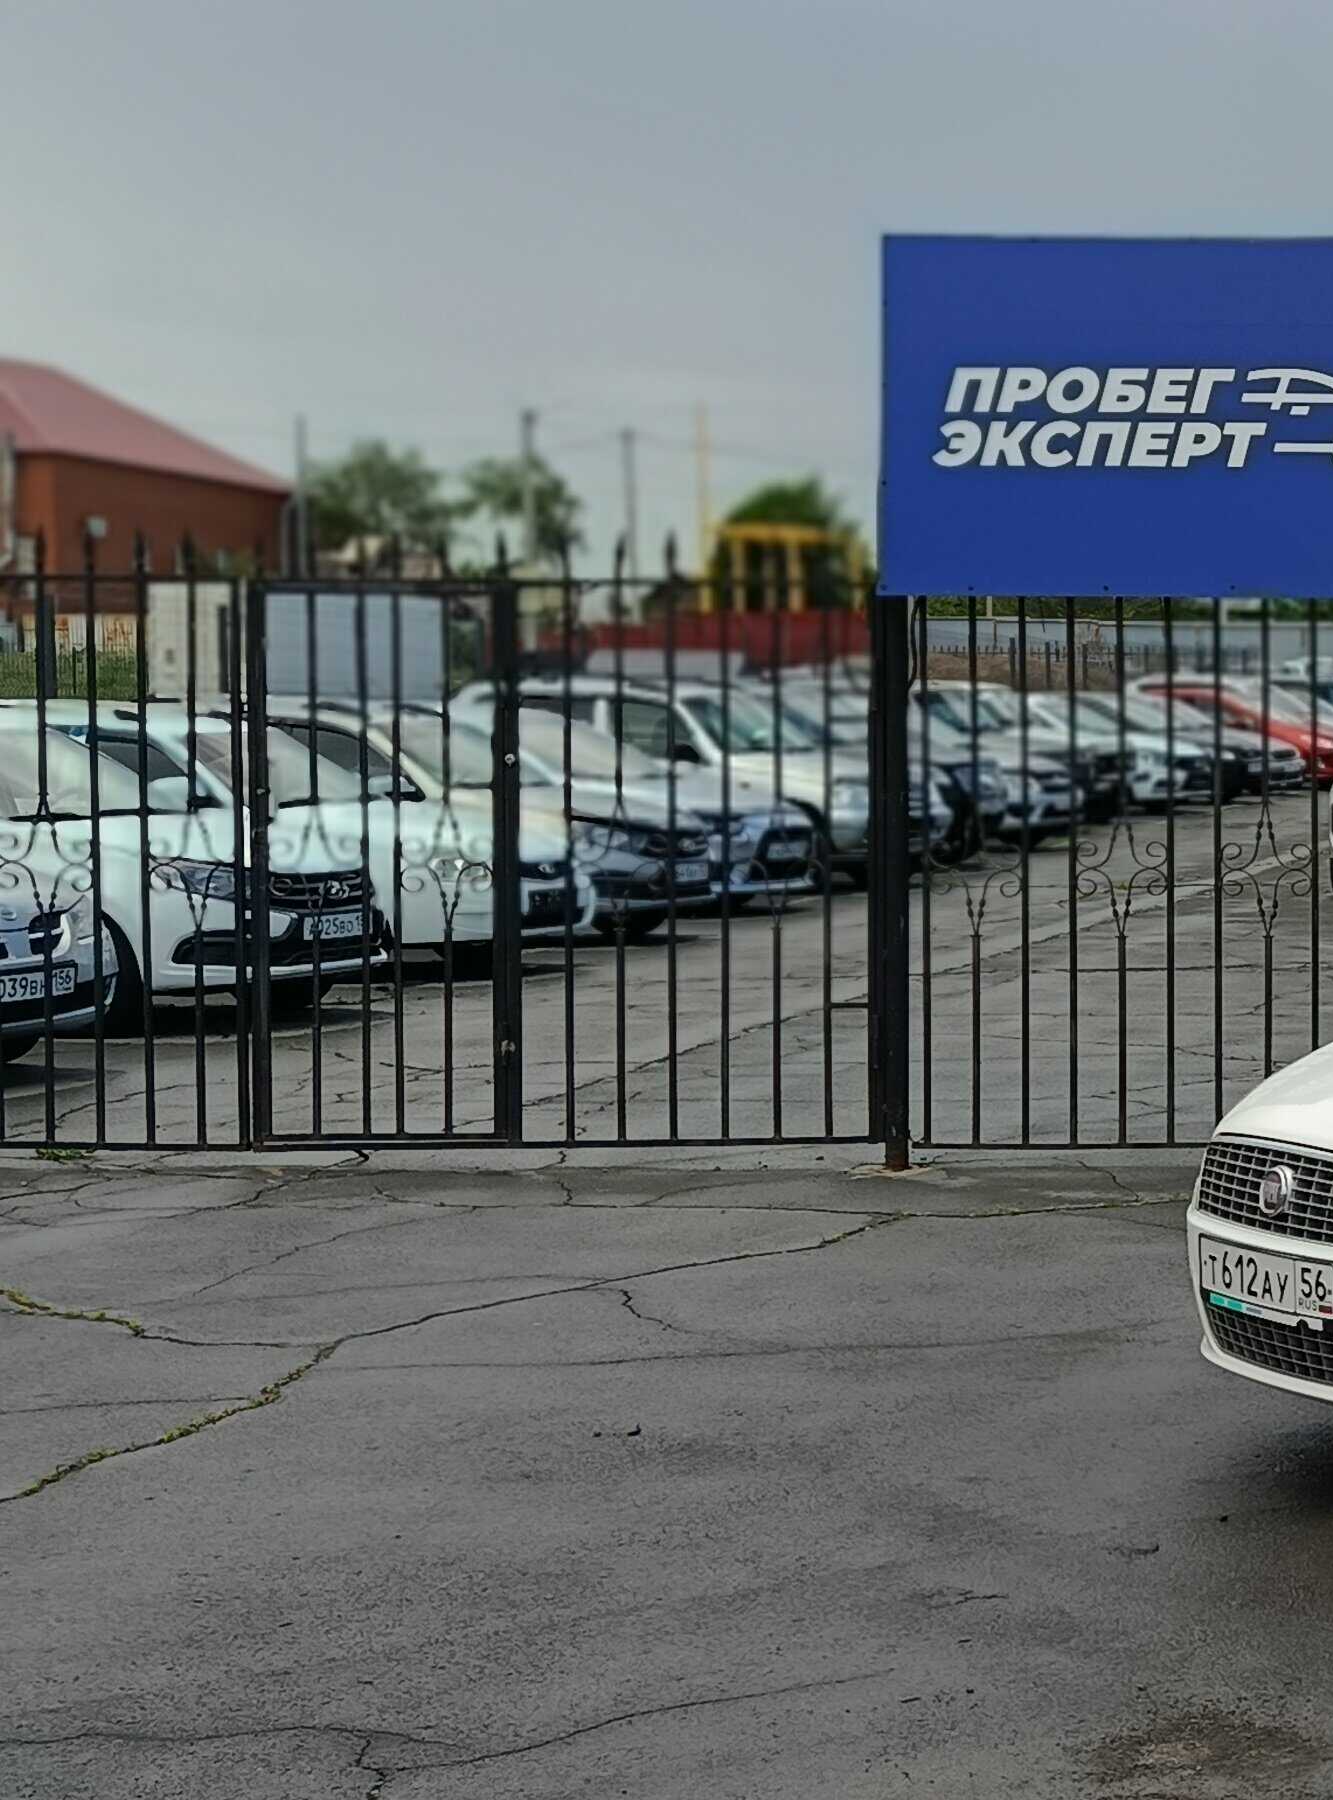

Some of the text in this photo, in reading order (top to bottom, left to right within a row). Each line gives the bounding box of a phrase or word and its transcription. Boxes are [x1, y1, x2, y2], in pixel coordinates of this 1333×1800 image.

[944, 367, 1236, 413] ПРОБЕГ
[932, 420, 1267, 467] ЭКСПЕРТ
[1208, 1250, 1327, 1303] Т612АУ 56
